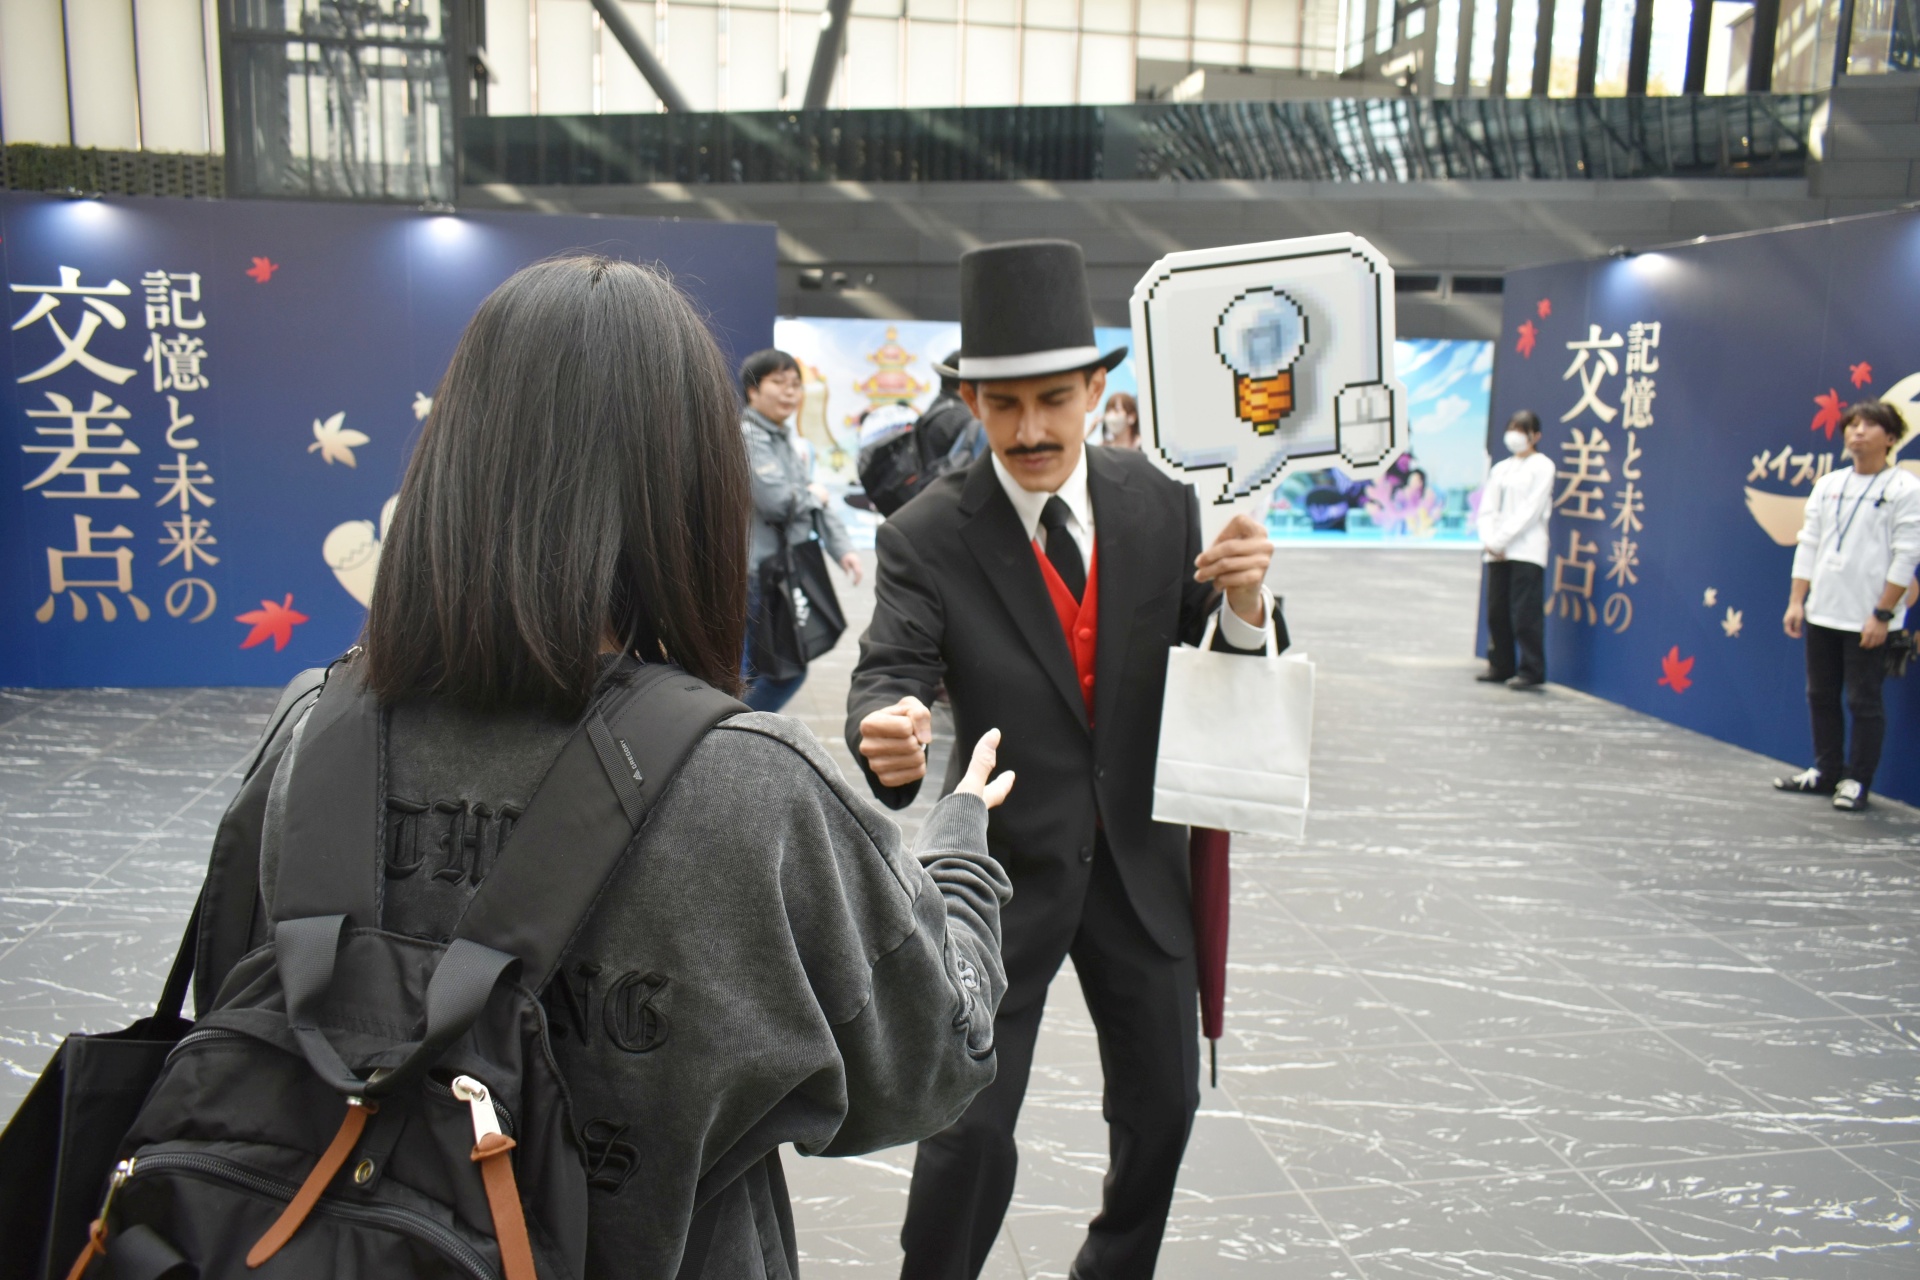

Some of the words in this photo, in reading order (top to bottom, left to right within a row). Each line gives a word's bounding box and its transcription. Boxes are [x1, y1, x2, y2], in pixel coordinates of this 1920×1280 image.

[9, 264, 151, 624] 交差点
[140, 269, 220, 624] 記憶と未来の
[1545, 323, 1624, 627] 交差点
[1603, 321, 1661, 634] 記憶と未来の
[619, 739, 638, 770] GREGORY
